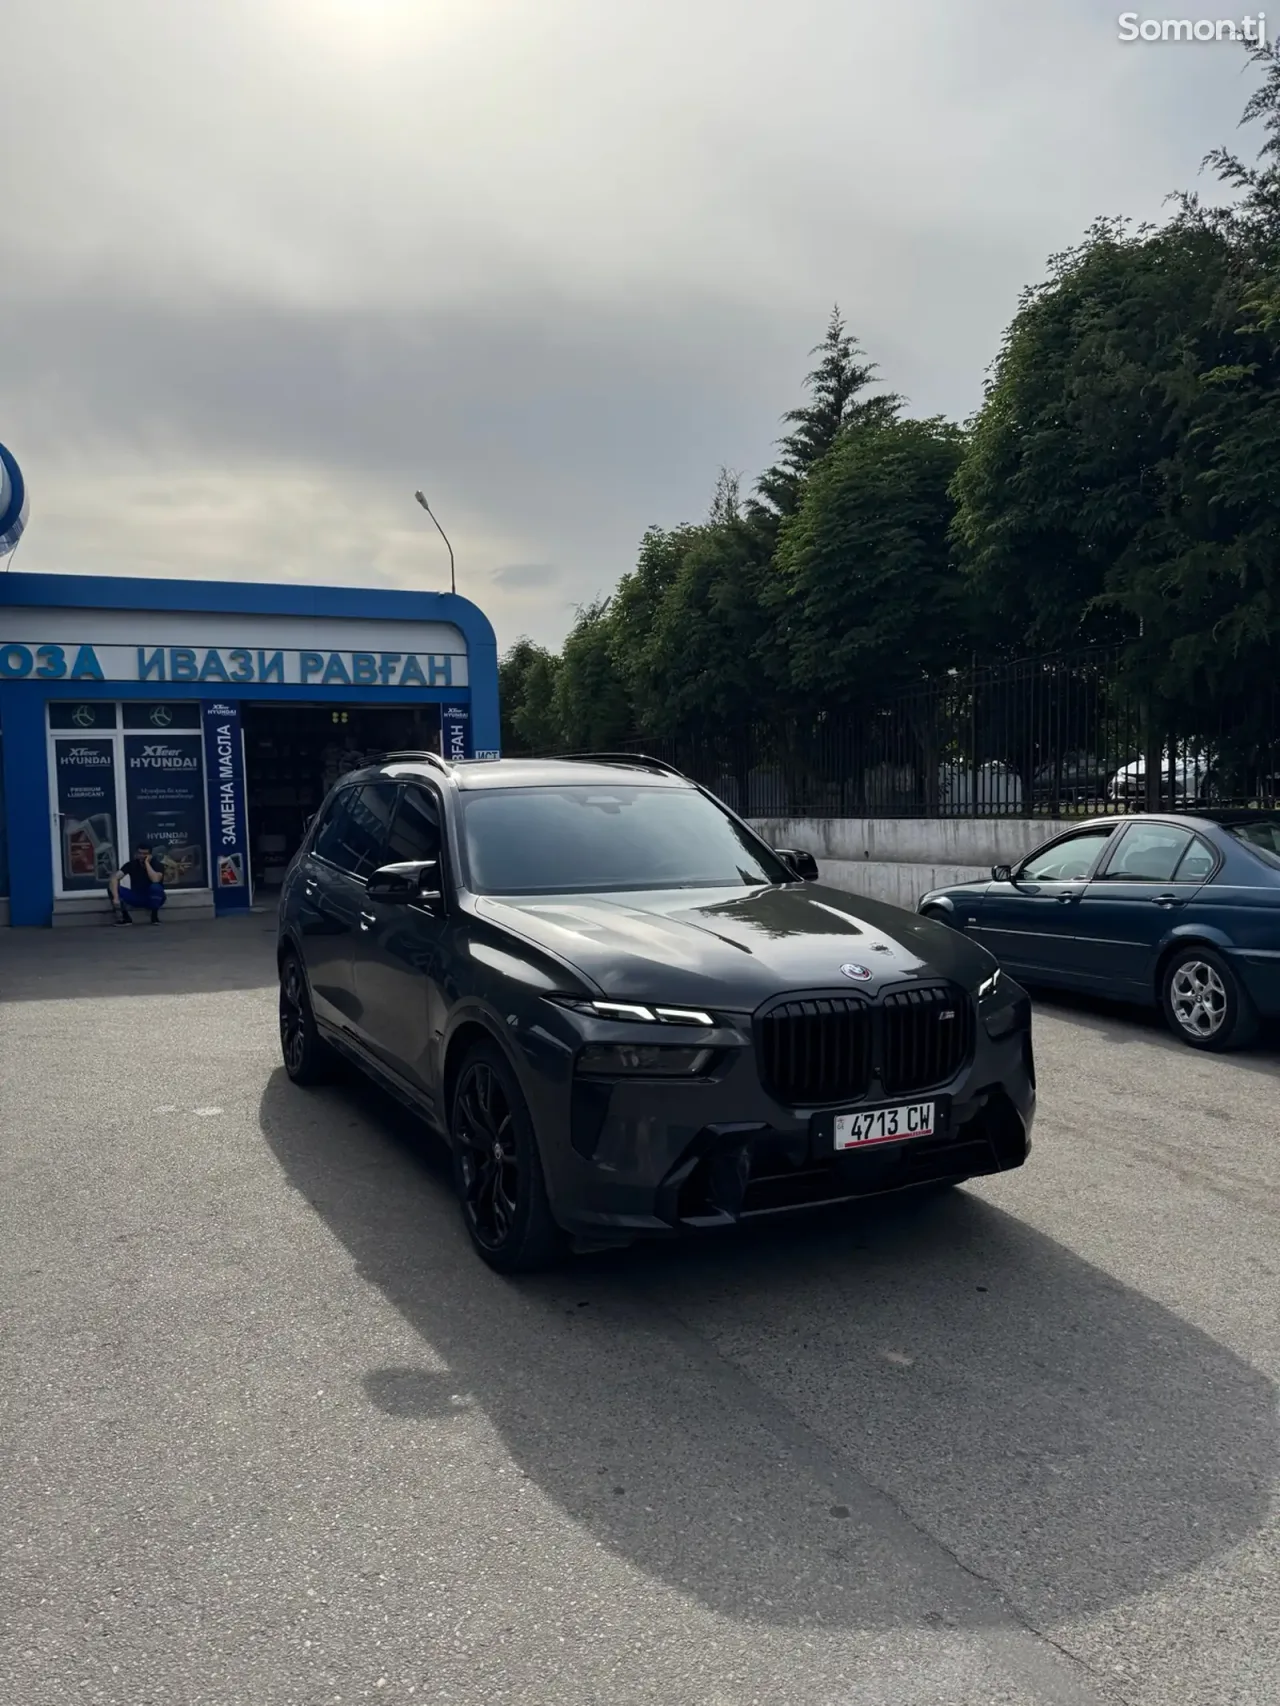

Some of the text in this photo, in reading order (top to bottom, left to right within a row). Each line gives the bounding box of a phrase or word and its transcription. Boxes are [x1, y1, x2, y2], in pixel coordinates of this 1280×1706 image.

[0, 643, 105, 680] ОЗА
[137, 647, 284, 683] ИВАЗИ
[60, 756, 111, 765] HYUNDAI
[130, 757, 197, 768] HYUNDAI
[216, 724, 233, 778] МАСЛА
[220, 782, 236, 845] ЗАМЕНА
[851, 1105, 930, 1141] 4713 CW
